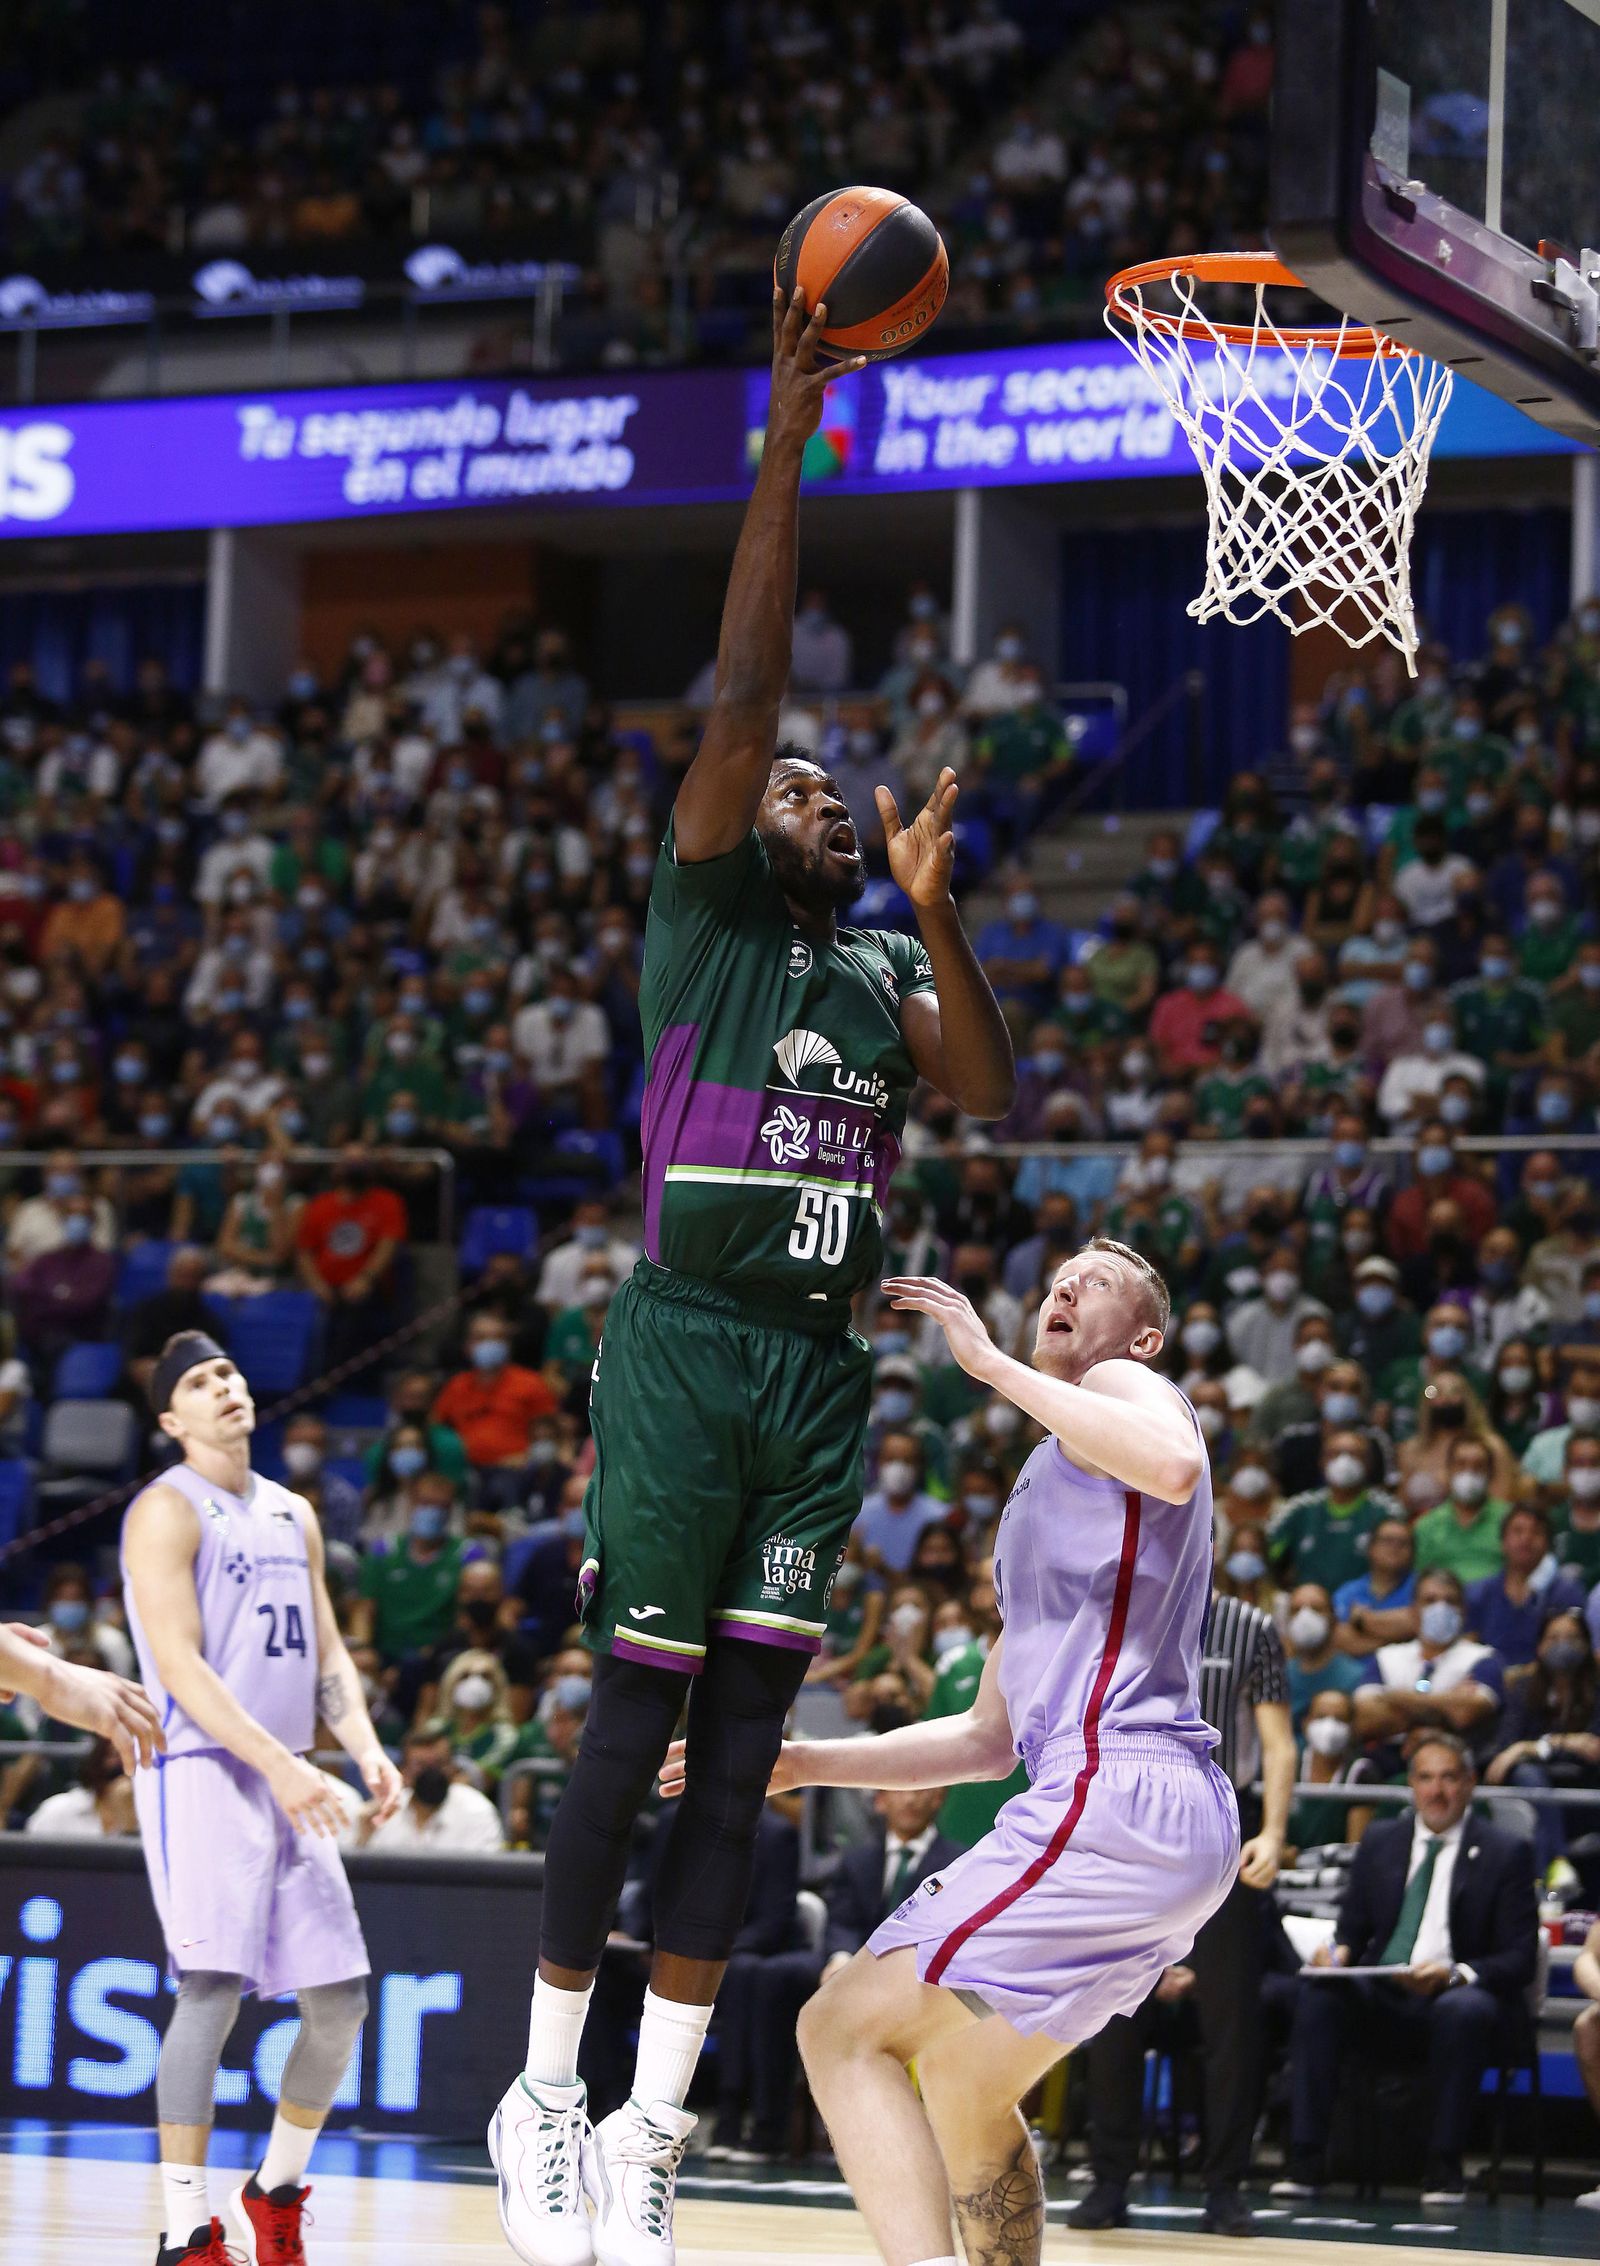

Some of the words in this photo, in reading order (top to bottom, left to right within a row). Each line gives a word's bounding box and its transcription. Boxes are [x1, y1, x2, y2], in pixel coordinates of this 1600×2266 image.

[882, 366, 996, 420] Your
[237, 404, 295, 460] Tu
[299, 395, 500, 464] segundo
[505, 390, 638, 454] lugar
[874, 422, 927, 474] in
[933, 417, 1018, 471] the
[1025, 406, 1176, 465] world
[344, 458, 407, 504] en
[411, 446, 466, 499] el
[465, 438, 634, 497] mundo
[817, 1146, 846, 1165] Deporte
[788, 1188, 849, 1266] 50
[762, 1556, 812, 1594] laga
[257, 1604, 307, 1658] 24
